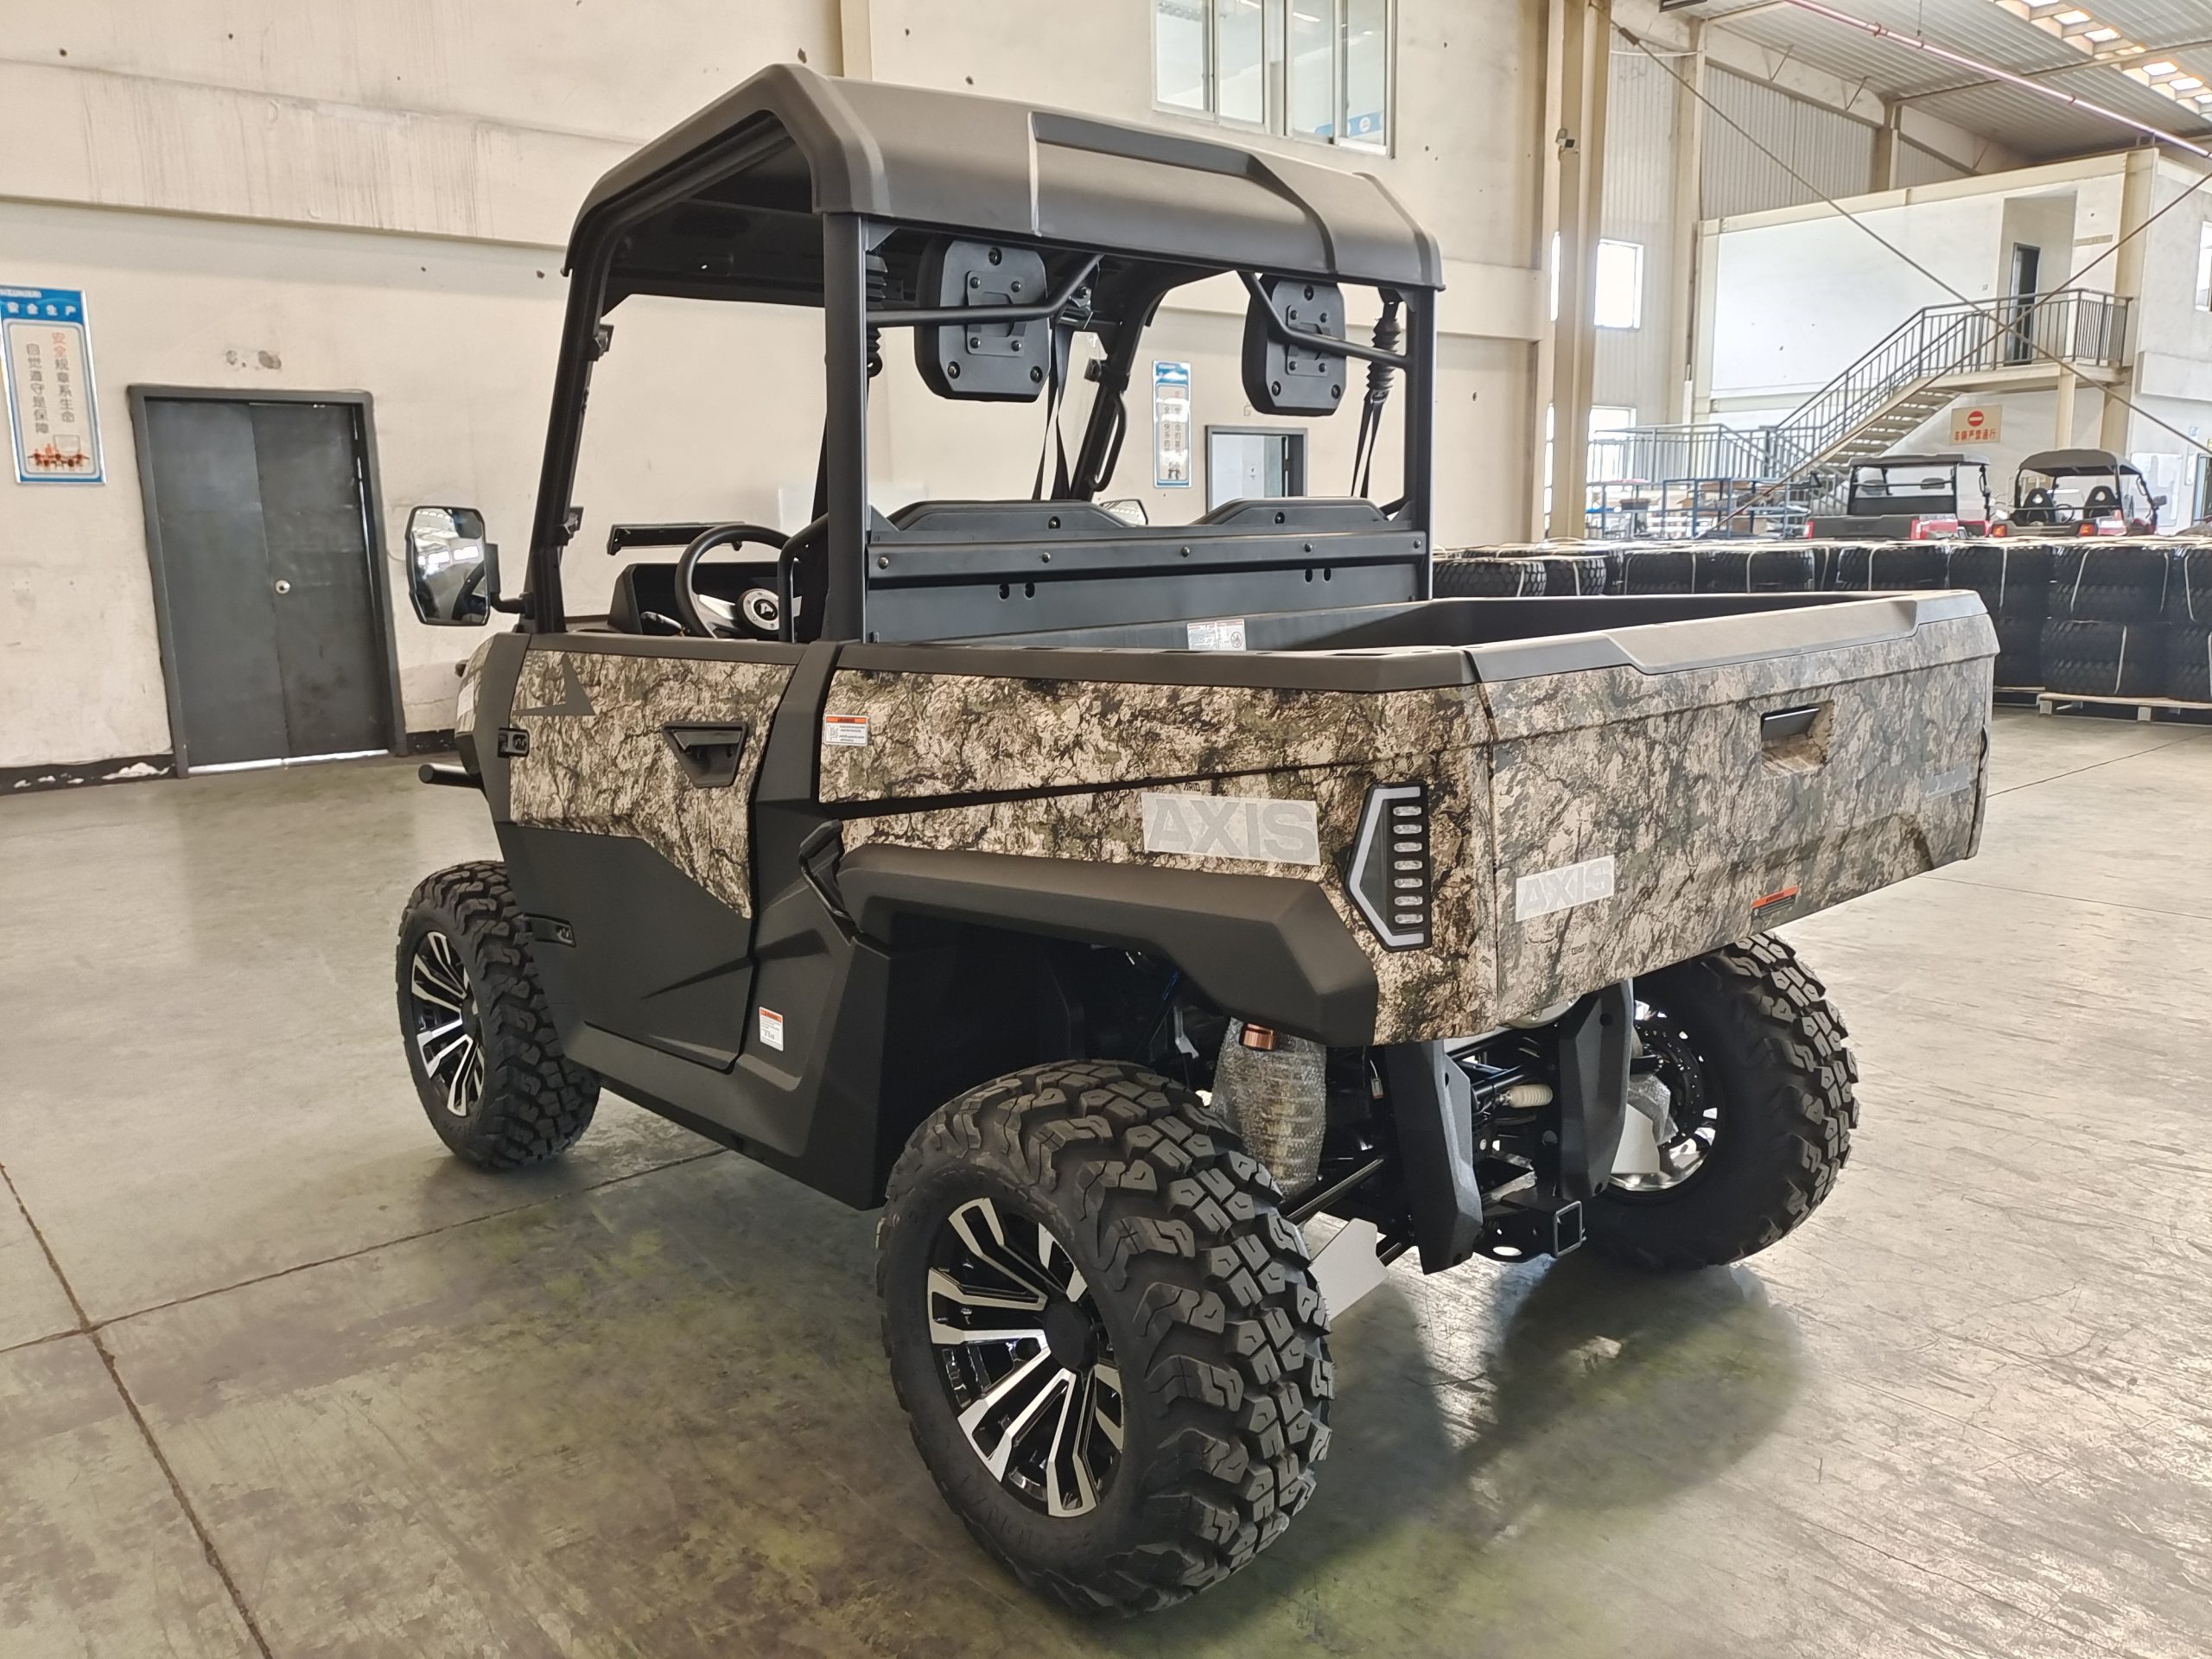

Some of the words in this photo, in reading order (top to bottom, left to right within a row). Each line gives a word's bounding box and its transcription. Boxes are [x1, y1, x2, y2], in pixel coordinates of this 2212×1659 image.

[26, 343, 49, 434] 自觉遵守是保障
[52, 332, 75, 423] 安全规章系生命
[1183, 782, 1201, 791] ARID
[1147, 798, 1318, 861] AXIS
[1520, 859, 1612, 917] AXIS
[1571, 943, 1587, 955] ARID
